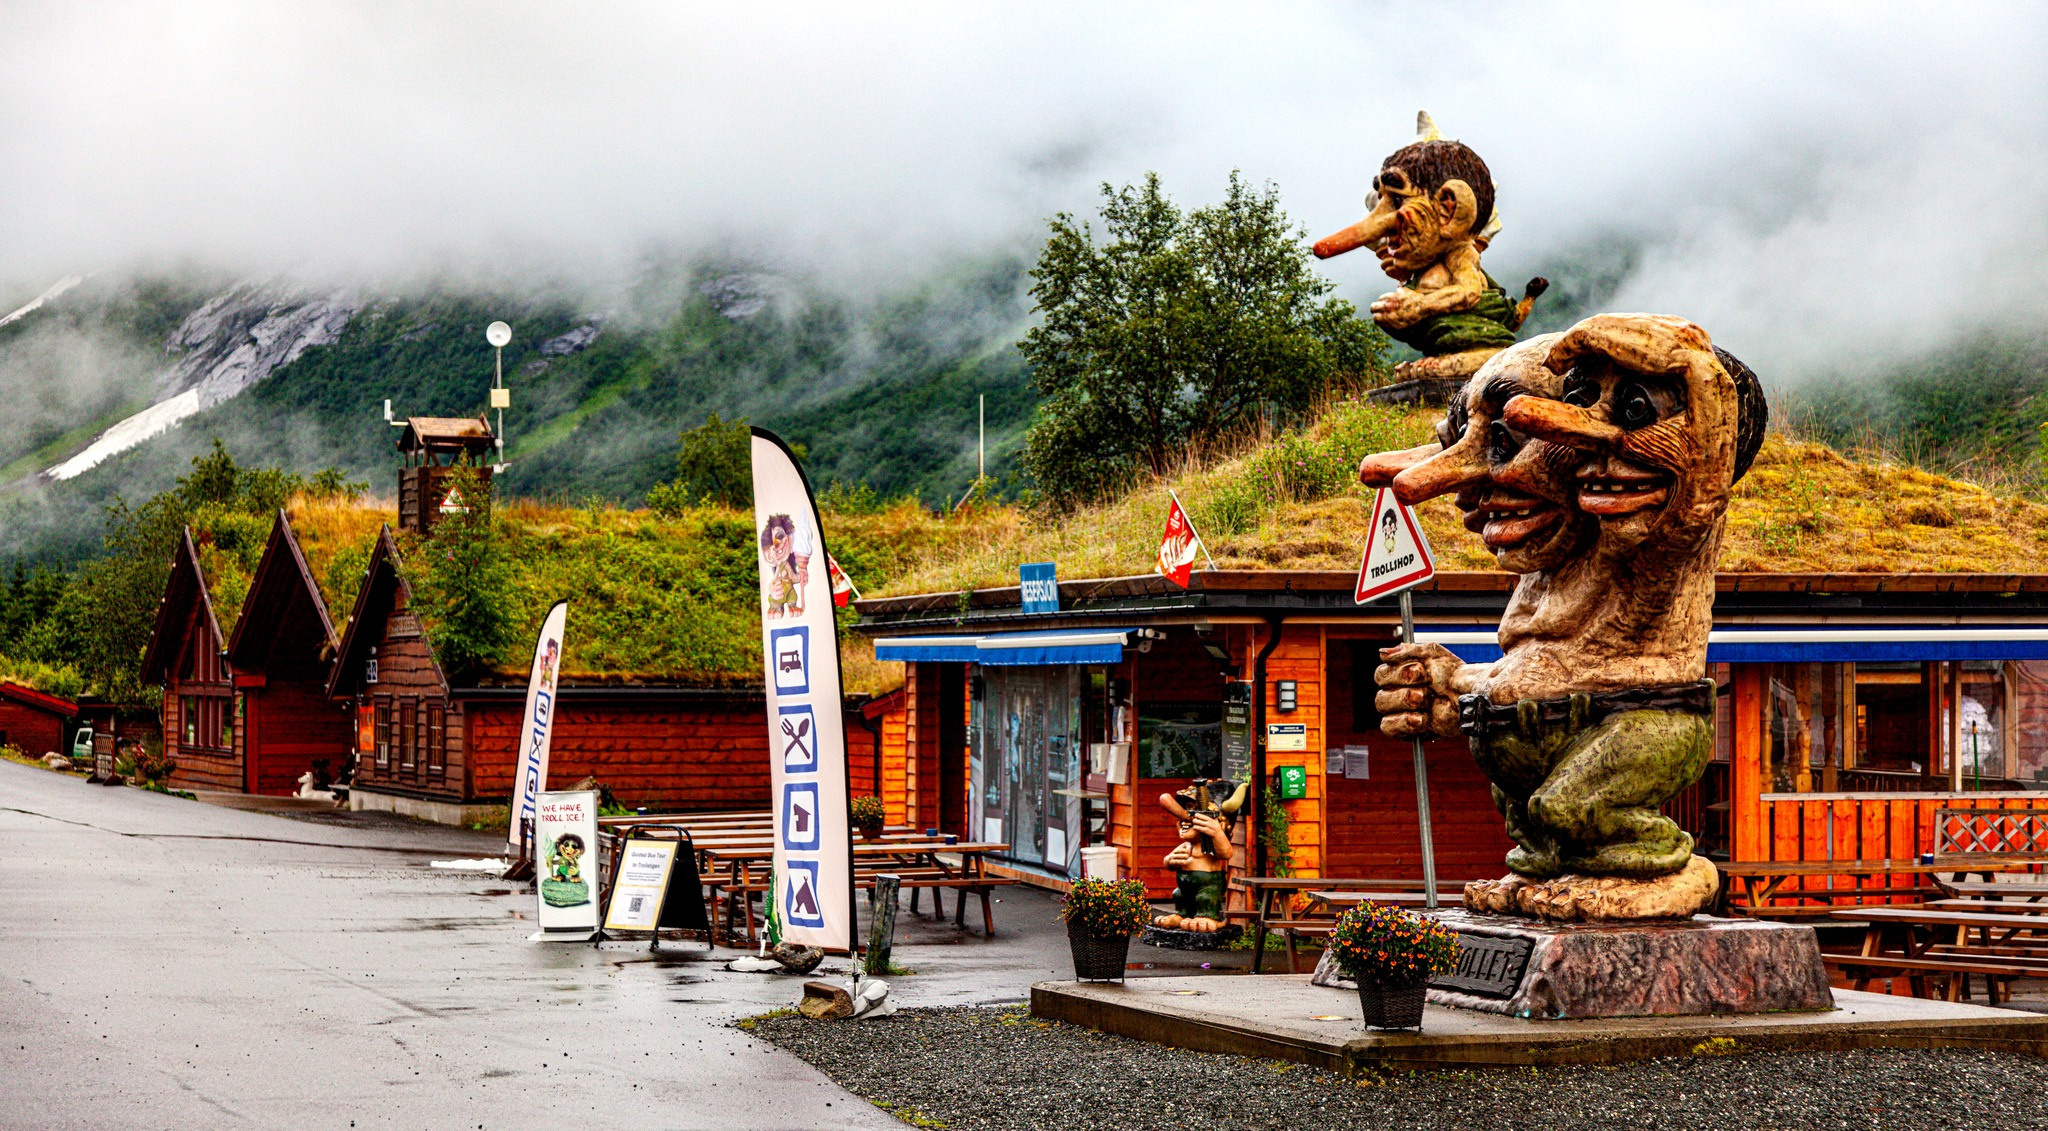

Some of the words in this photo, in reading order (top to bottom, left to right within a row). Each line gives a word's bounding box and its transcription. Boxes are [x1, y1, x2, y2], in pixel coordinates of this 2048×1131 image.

[1371, 553, 1415, 579] TROLLSHOP
[542, 804, 557, 813] WE
[559, 803, 582, 812] HAVE
[541, 814, 563, 822] TROLL
